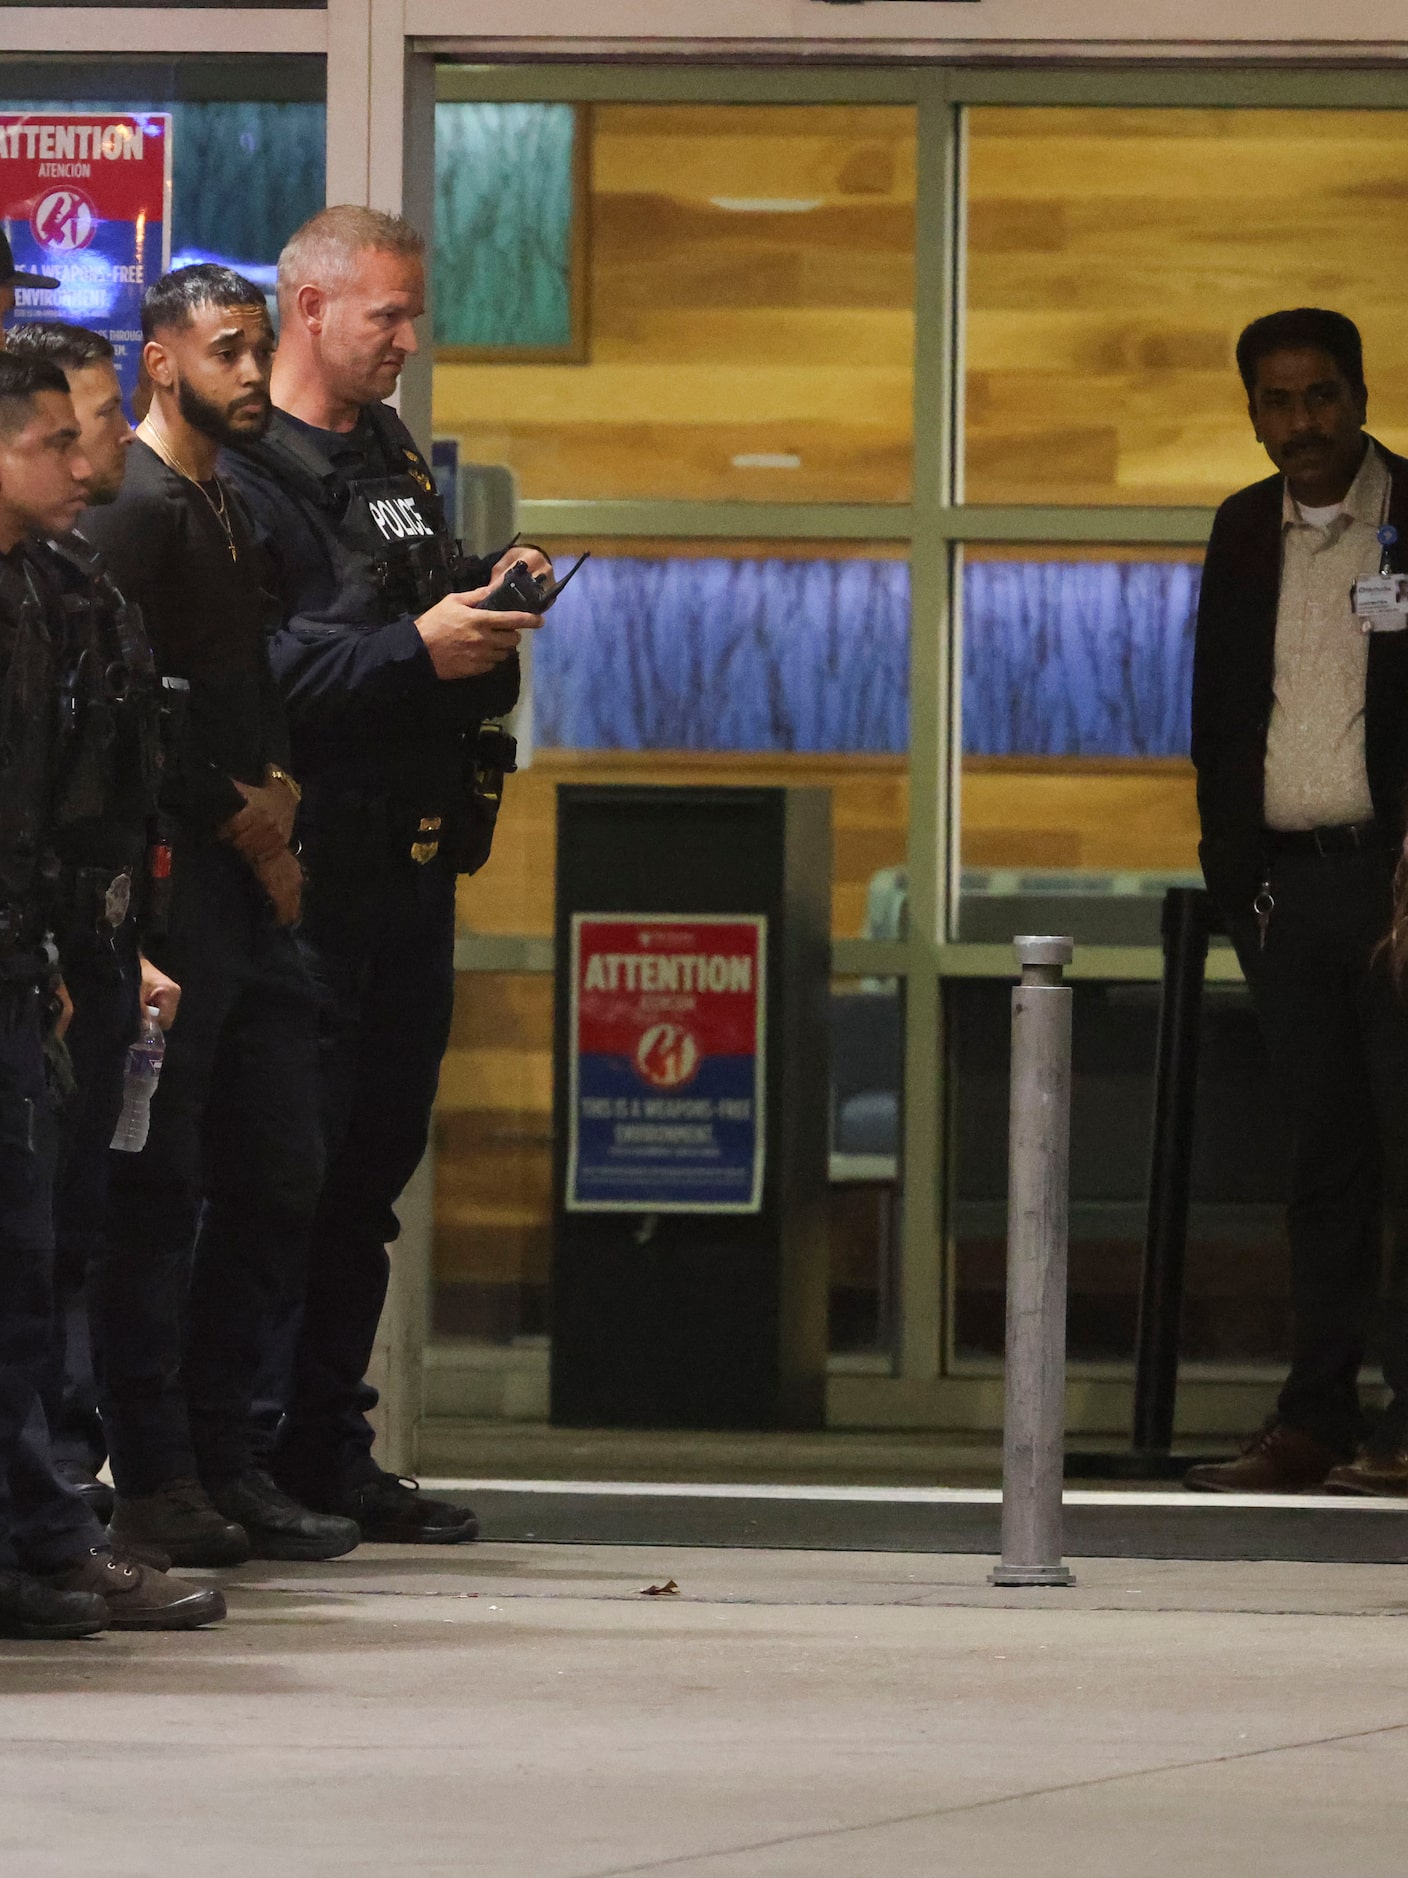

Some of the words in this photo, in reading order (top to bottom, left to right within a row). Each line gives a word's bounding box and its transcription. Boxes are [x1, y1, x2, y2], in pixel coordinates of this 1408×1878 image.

[38, 161, 91, 178] ATENCIÓN
[368, 497, 434, 540] POLICE
[584, 954, 752, 992] ATTENTION
